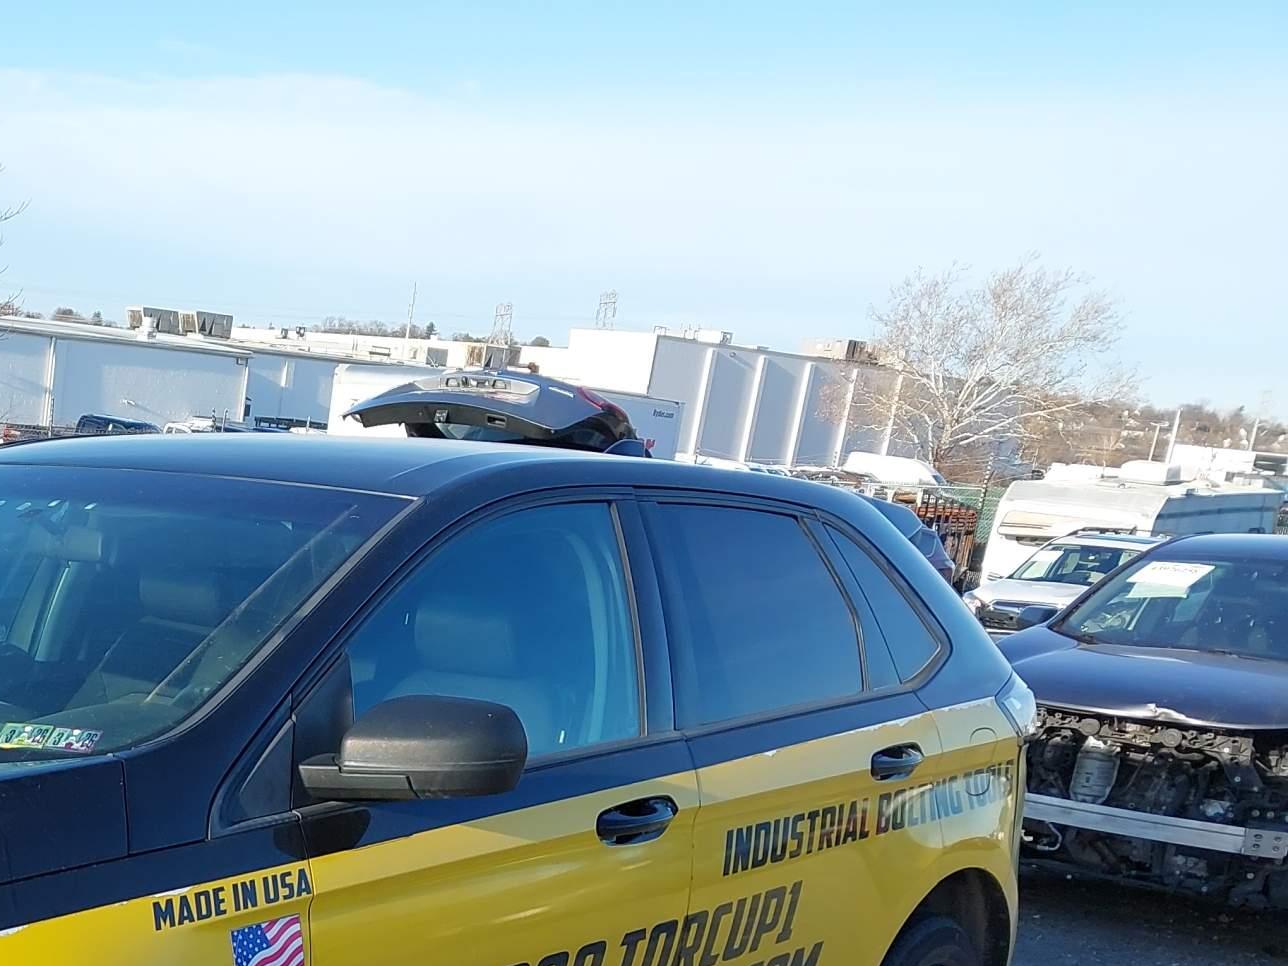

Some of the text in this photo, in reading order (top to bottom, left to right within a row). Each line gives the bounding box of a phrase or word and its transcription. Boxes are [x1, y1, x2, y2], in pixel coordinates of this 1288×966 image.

[722, 797, 870, 876] INDUSTRIAL
[152, 868, 313, 931] MADE IN USA
